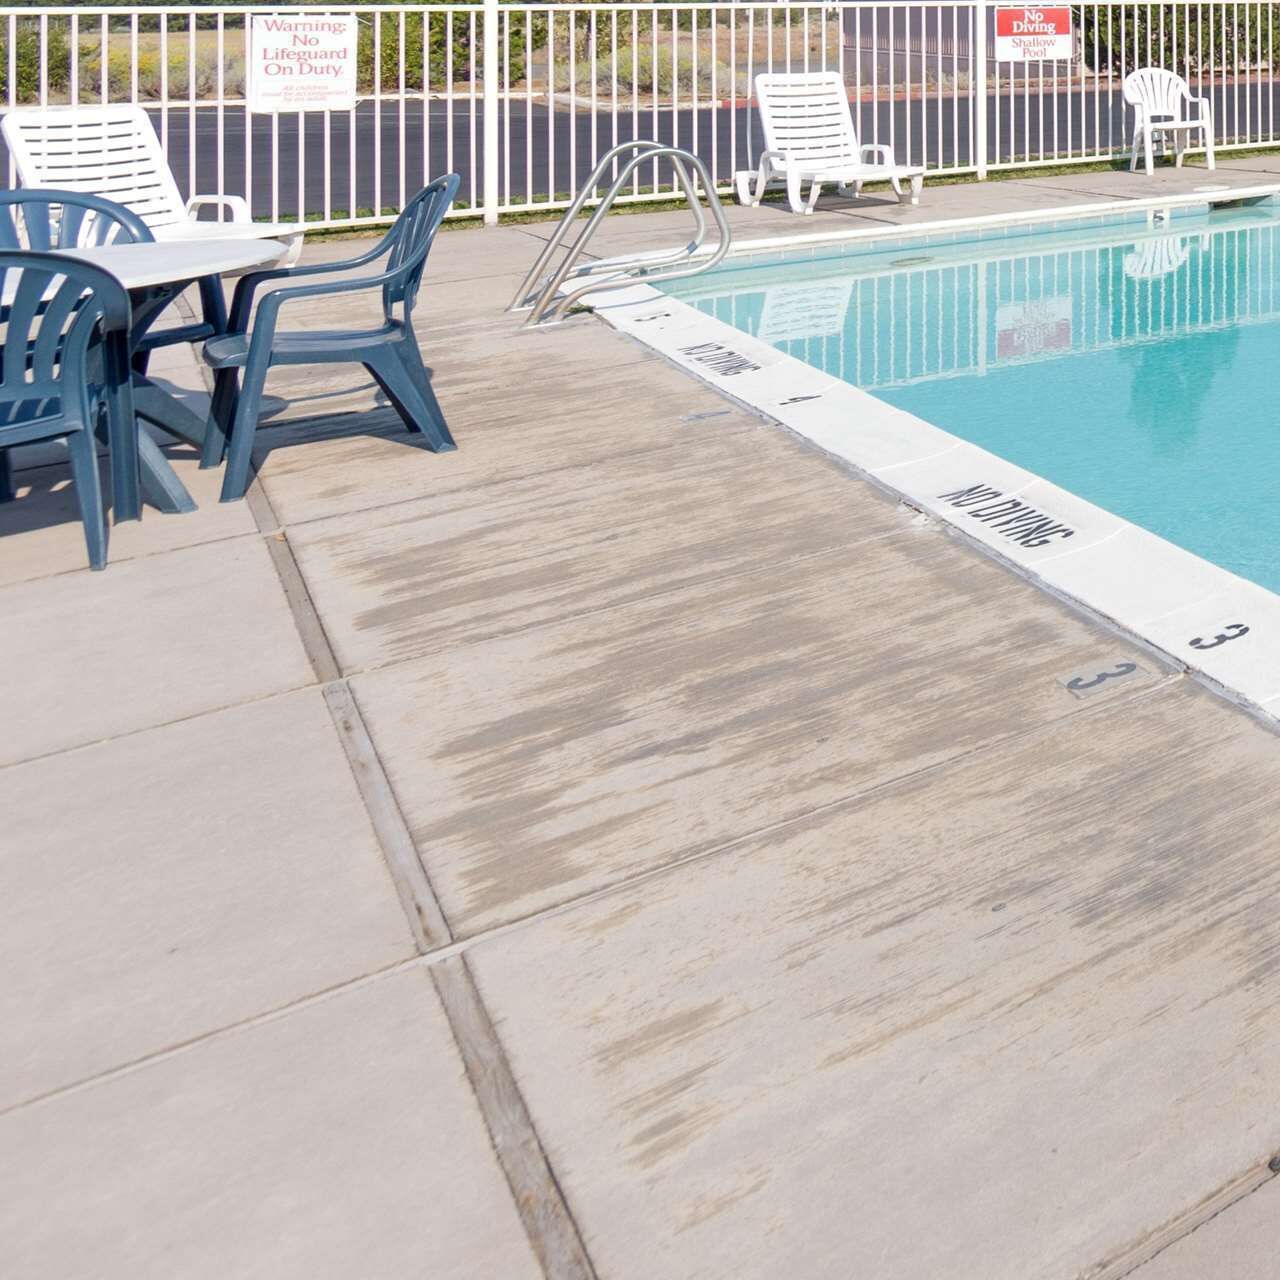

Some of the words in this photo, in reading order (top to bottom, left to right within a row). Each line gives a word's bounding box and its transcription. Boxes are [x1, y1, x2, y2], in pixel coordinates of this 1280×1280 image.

[1023, 9, 1044, 22] No
[264, 19, 348, 35] Warning:
[1012, 21, 1057, 35] Diving
[292, 33, 320, 47] No
[1011, 37, 1057, 49] Shallow
[262, 48, 348, 63] Lifeguard
[1023, 47, 1047, 58] Pool
[264, 63, 293, 76] On
[694, 350, 762, 377] DIVING
[935, 483, 1003, 509] NO
[966, 498, 1075, 548] DIVING
[1189, 623, 1250, 650] 3
